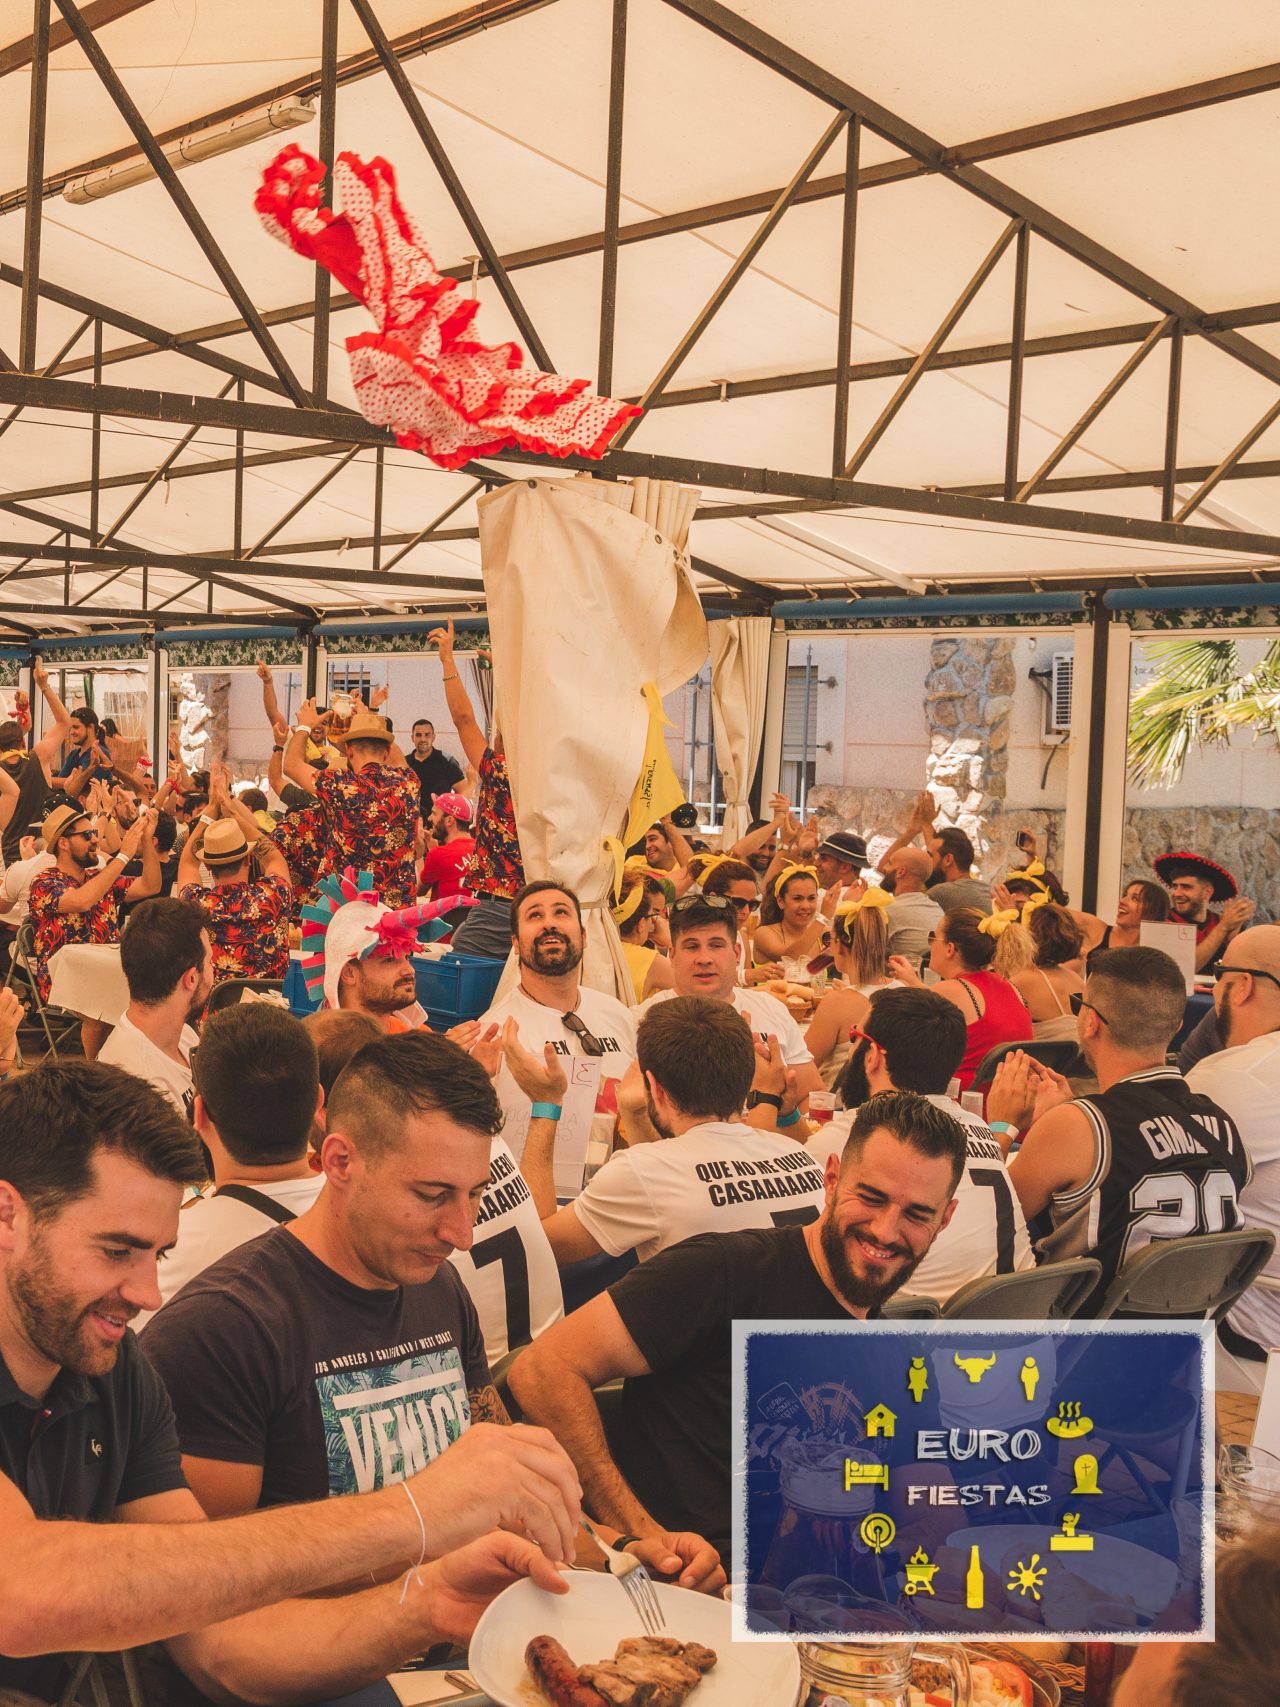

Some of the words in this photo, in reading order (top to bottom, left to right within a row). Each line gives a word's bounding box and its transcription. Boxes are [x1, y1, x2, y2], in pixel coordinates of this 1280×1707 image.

[695, 1160, 733, 1182] QUE
[730, 1160, 757, 1176] NO
[751, 1160, 779, 1174] ME
[1119, 1168, 1246, 1260] 20
[968, 1168, 1017, 1275] 7
[469, 1225, 534, 1353] 7
[331, 1352, 368, 1369] ANGELES
[419, 1336, 436, 1349] WEST
